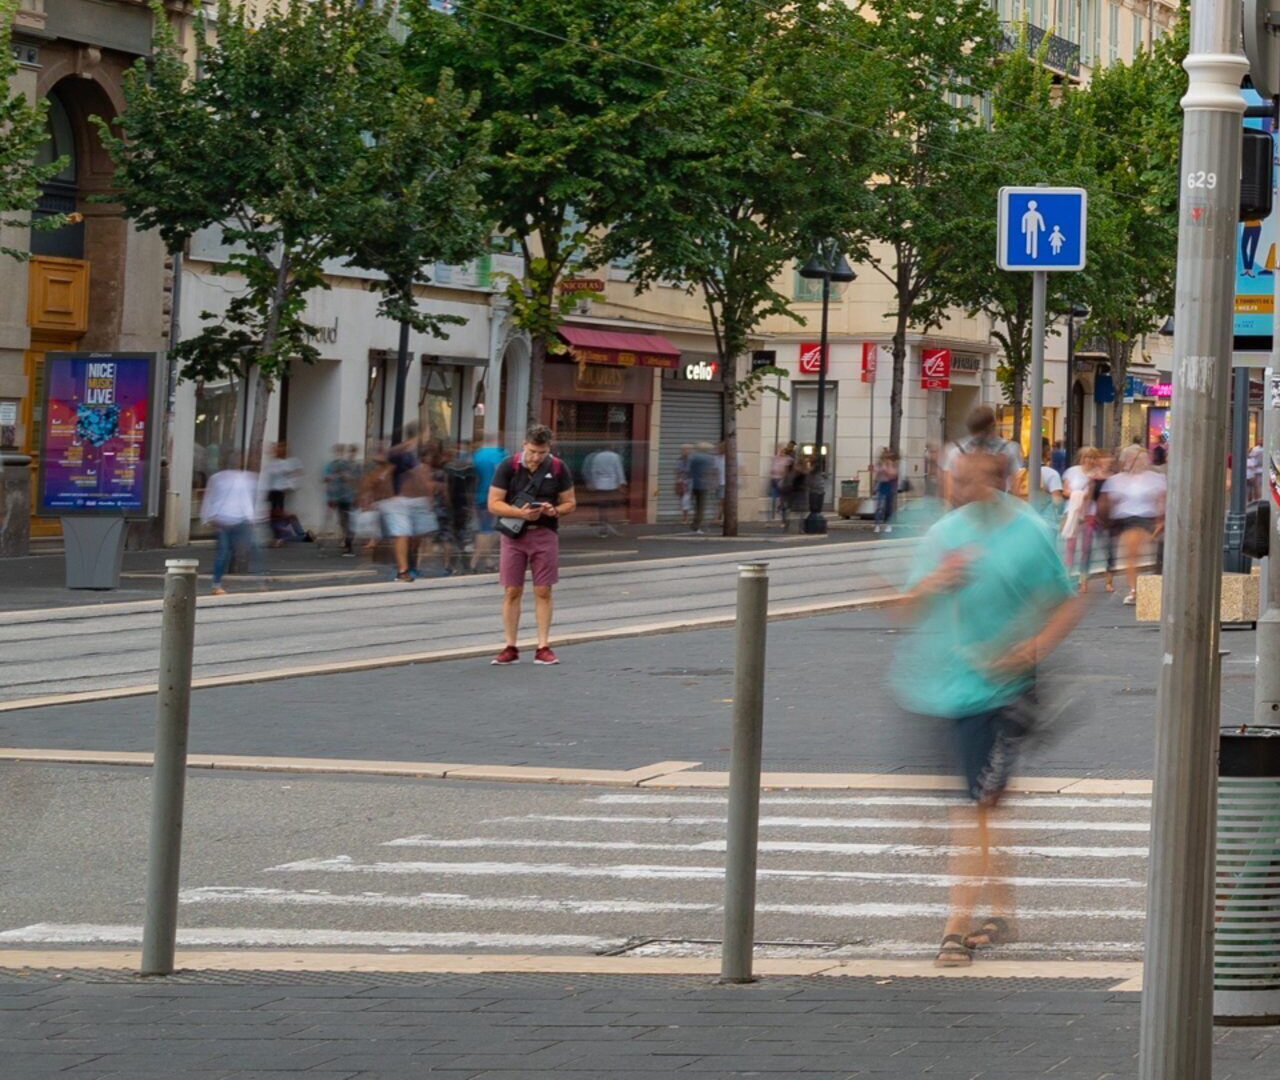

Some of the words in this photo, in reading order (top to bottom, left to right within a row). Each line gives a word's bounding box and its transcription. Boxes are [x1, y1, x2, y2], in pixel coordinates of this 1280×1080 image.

[1187, 170, 1217, 189] 629
[88, 362, 115, 378] NICE
[87, 388, 114, 404] LIVE
